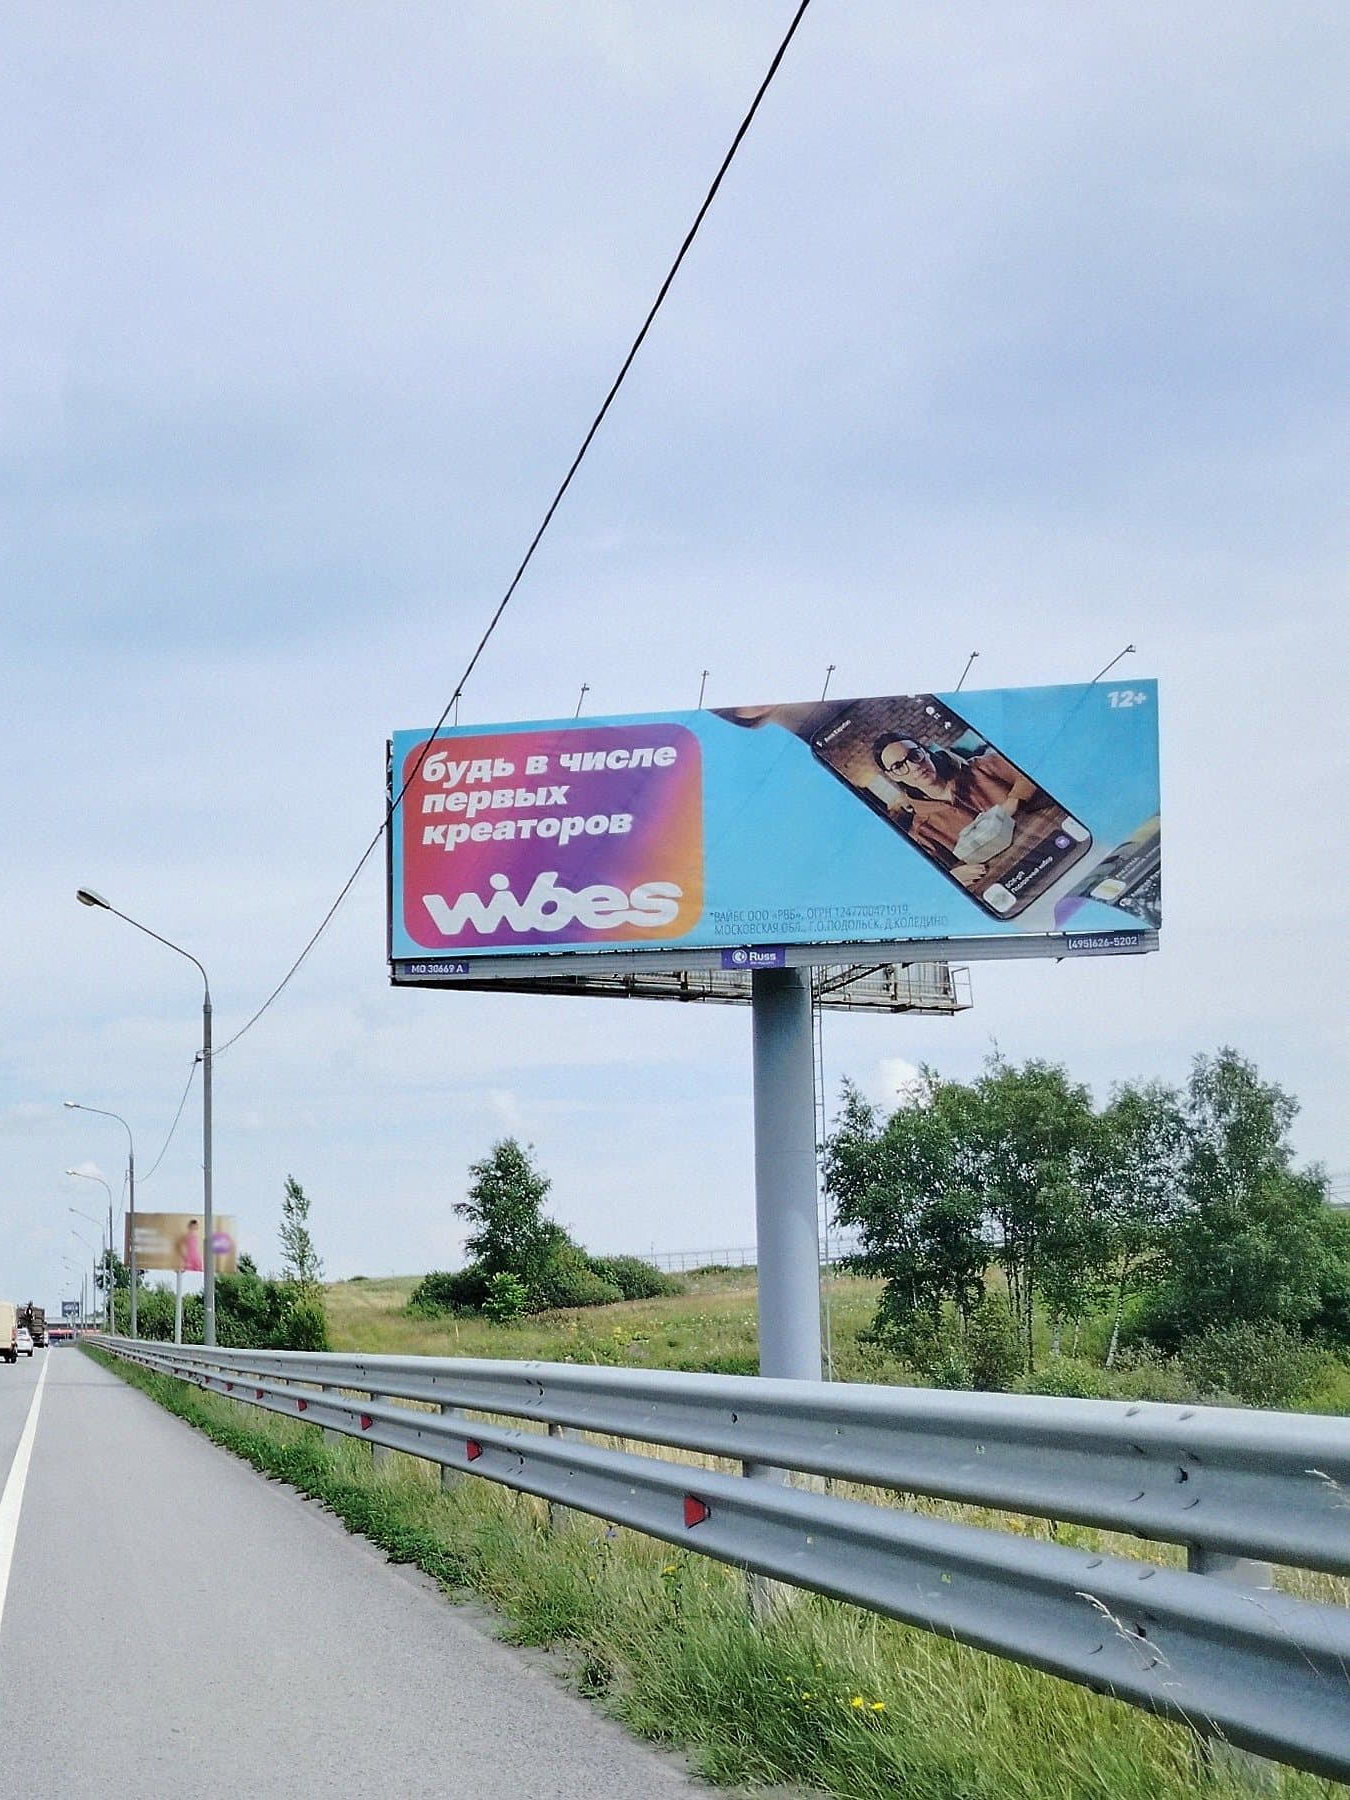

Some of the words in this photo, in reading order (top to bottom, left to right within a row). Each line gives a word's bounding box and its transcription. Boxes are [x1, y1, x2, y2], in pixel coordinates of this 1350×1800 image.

[1106, 689, 1147, 708] 12+
[421, 751, 515, 789] будь
[525, 755, 549, 776] в
[559, 746, 678, 772] числе
[421, 785, 571, 818] первых
[422, 813, 634, 851] креаторов
[422, 871, 684, 936] wibes
[806, 907, 832, 919] ОГРН
[714, 922, 779, 936] МОСКОВСКАЯ
[1068, 936, 1138, 950] (495)626-5202
[749, 951, 777, 961] Russ
[427, 964, 454, 973] 30669
[456, 964, 464, 973] А
